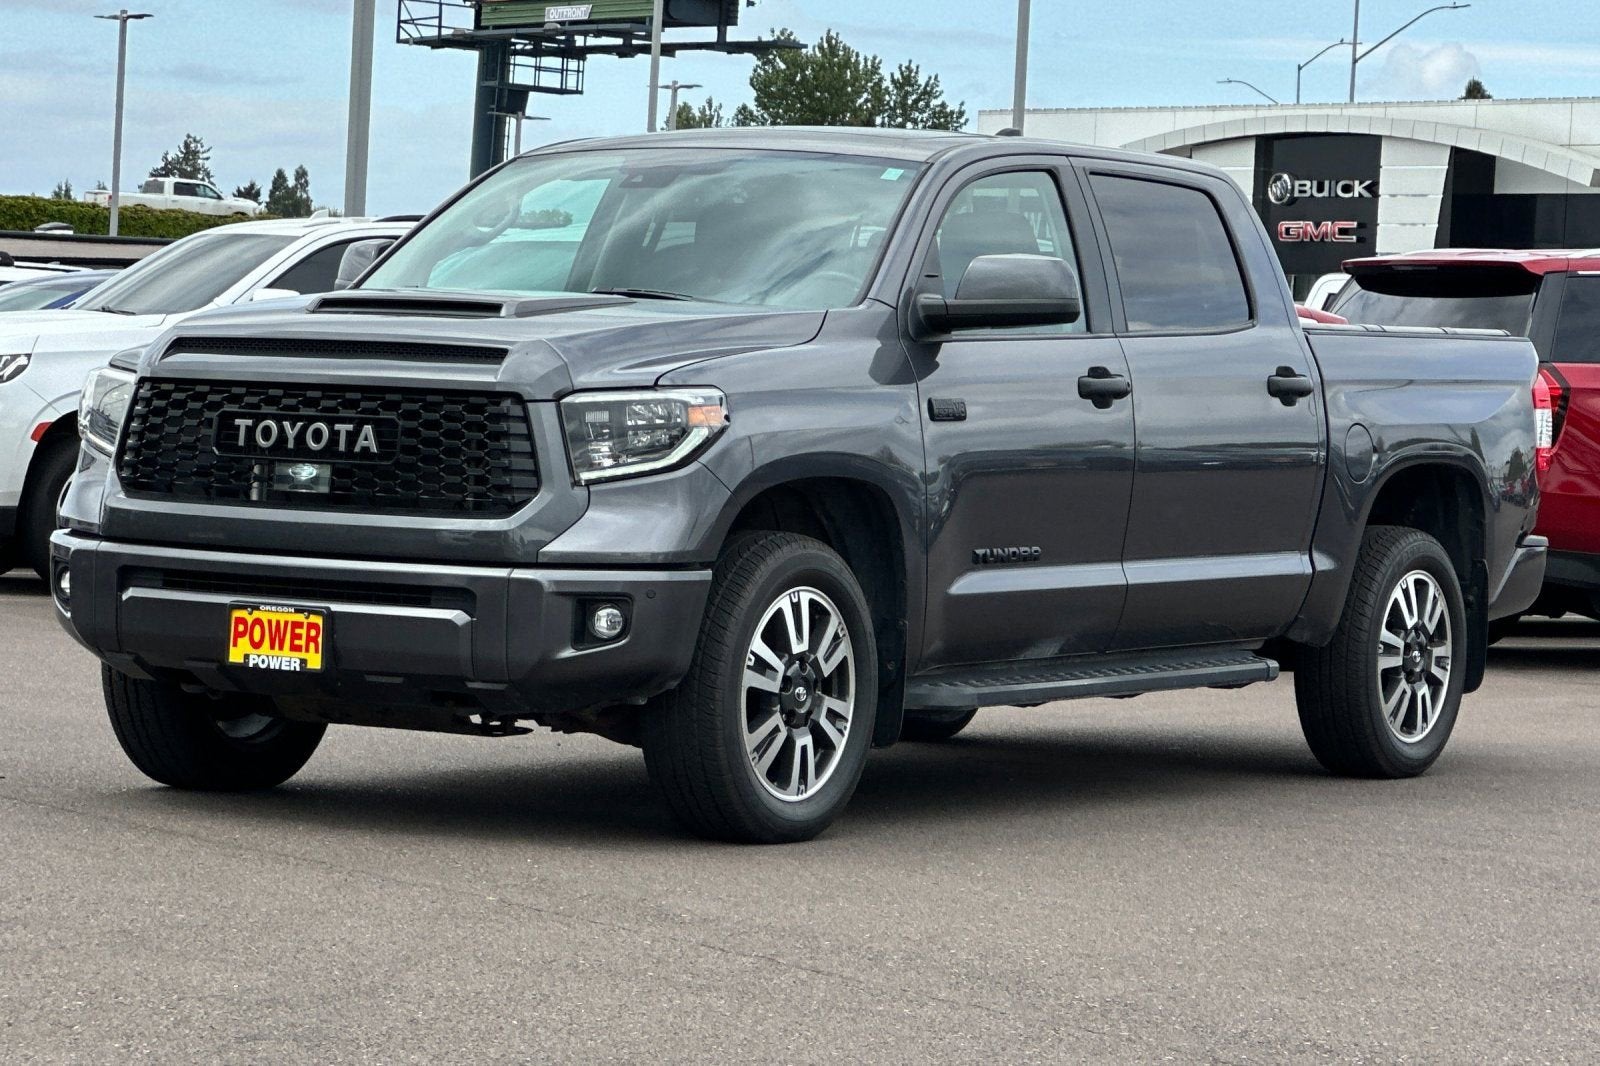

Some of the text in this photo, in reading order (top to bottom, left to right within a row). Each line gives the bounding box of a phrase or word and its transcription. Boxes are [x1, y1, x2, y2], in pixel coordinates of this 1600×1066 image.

[550, 7, 586, 19] OUTFRONT
[1294, 179, 1373, 198] BUICK
[1277, 220, 1358, 242] GMC
[234, 418, 378, 454] TOYOTA
[972, 546, 1041, 564] TUNDRA
[259, 605, 295, 613] OREGON
[232, 616, 321, 654] POWER
[248, 654, 301, 671] POWER
